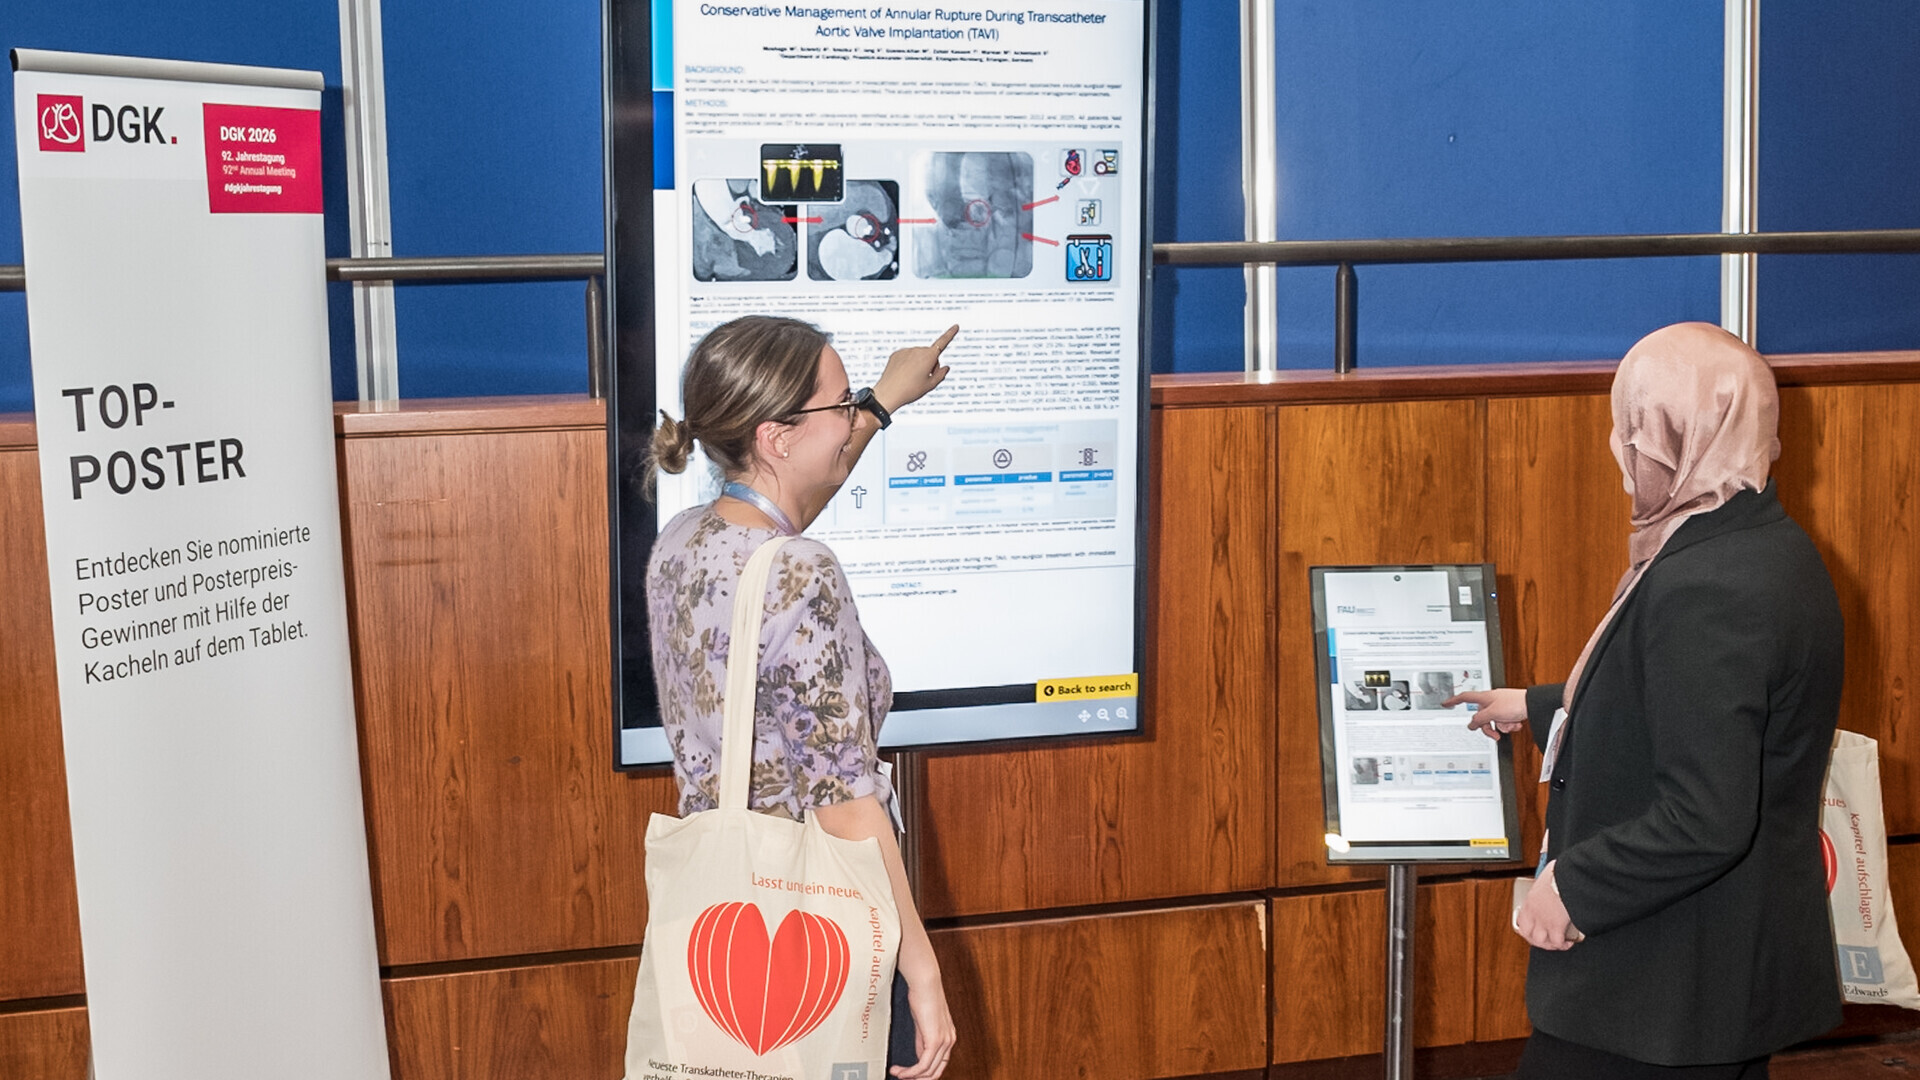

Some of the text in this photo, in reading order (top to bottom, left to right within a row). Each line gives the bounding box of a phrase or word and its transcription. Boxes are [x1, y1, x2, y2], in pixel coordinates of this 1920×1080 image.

[700, 4, 1106, 26] Conservative Management of Annular Rupture During Transcatheter
[815, 25, 1000, 41] Aortic Valve Implantation (TAVI)
[92, 103, 177, 145] DGK.
[220, 126, 277, 144] DGK 2026
[221, 151, 286, 166] 92. Jahrestagung
[239, 165, 266, 177] Annual
[266, 167, 296, 179] Meeting
[224, 183, 282, 195] #dgkjahrestagung
[62, 382, 175, 432] TOP-
[69, 438, 246, 500] POSTER
[76, 525, 311, 580] Entdecken Sie nominierte
[79, 558, 298, 615] Poster und Posterpreis-
[82, 592, 290, 649] Gewinner mit Hilfe der
[85, 620, 308, 684] Kacheln auf dem Tablet.
[1058, 682, 1132, 695] Back to search
[752, 872, 784, 890] Lasst
[805, 882, 825, 895] ein
[1850, 812, 1874, 932] Kapitel aufschlagen.
[1847, 951, 1873, 980] E
[861, 955, 882, 1043] aufschlagen.
[1843, 984, 1889, 998] Edwards
